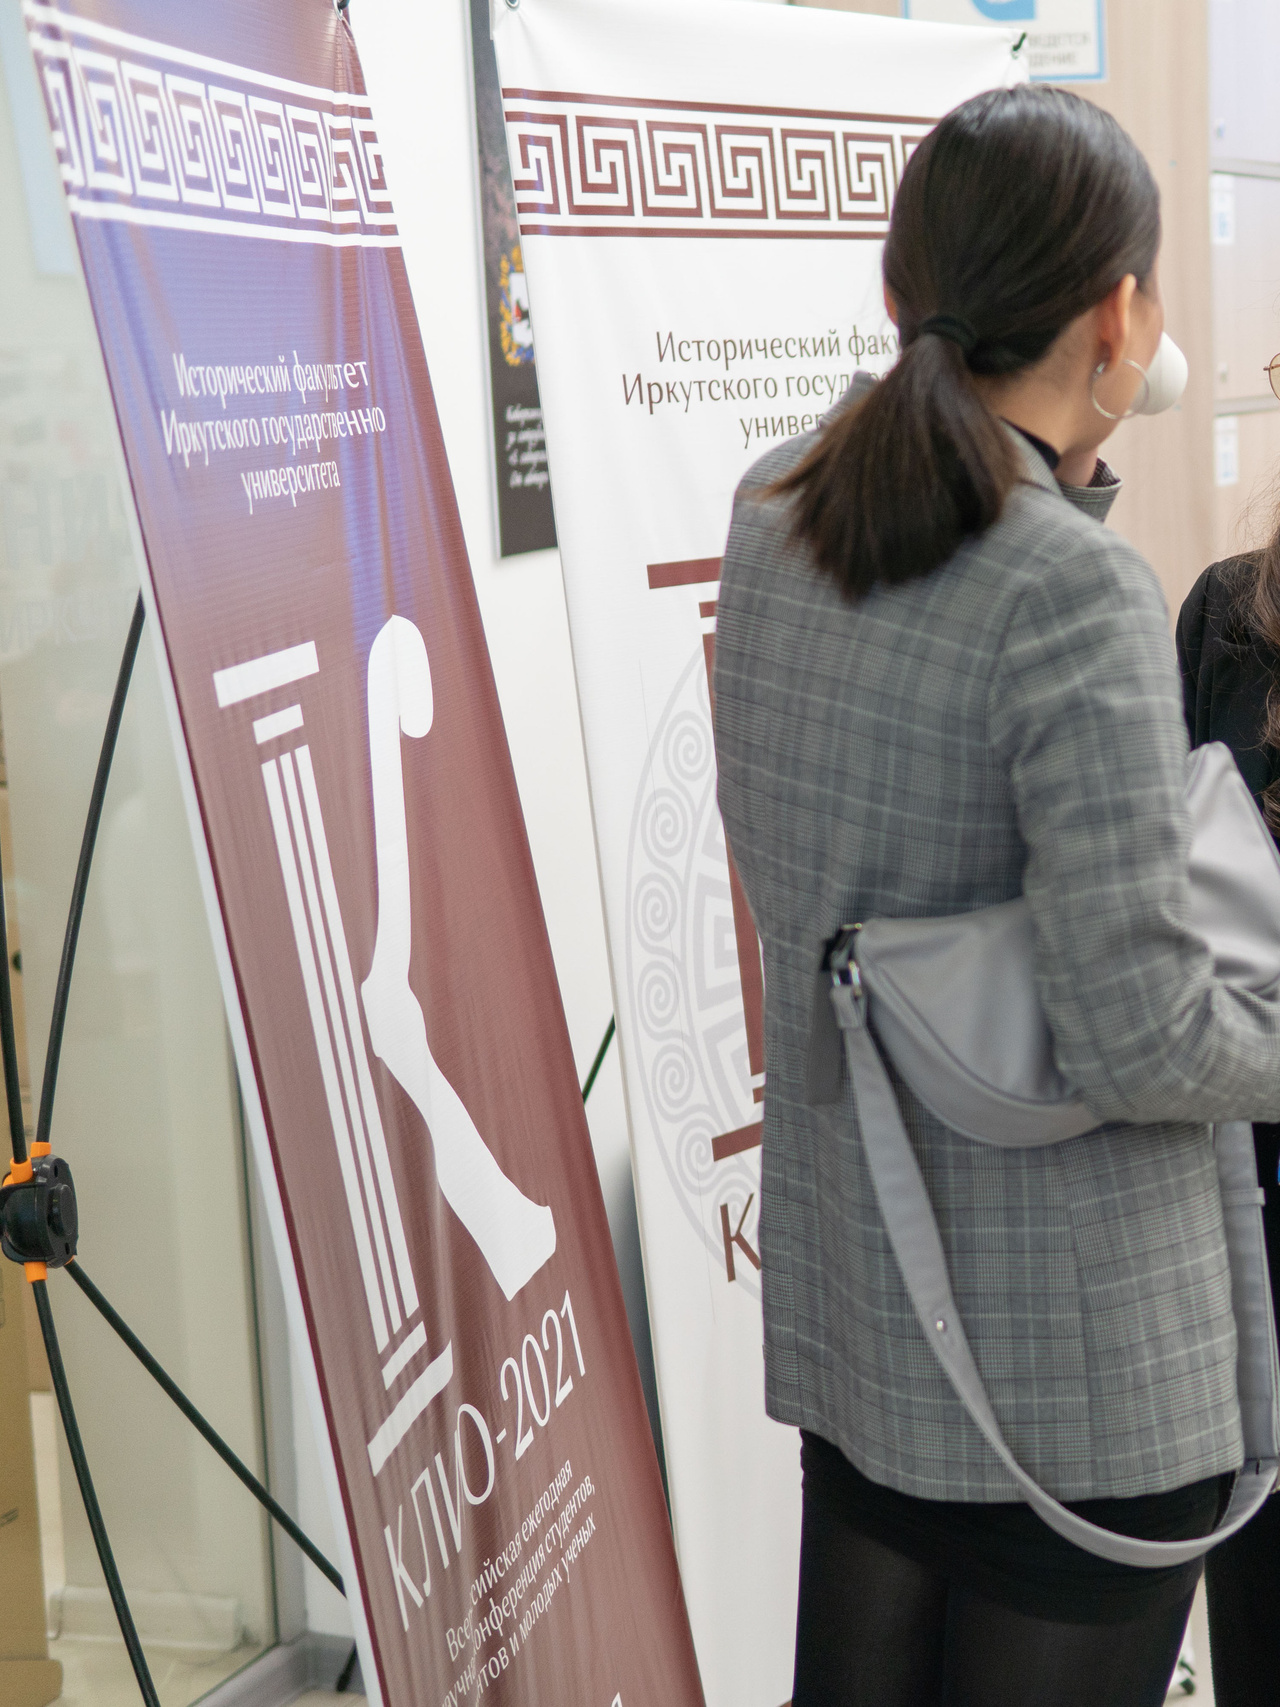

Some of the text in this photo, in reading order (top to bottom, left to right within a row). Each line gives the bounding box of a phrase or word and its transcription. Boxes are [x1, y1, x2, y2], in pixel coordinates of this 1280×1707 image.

[656, 329, 840, 370] Исторический
[173, 350, 368, 409] Исторический факультет
[622, 373, 777, 414] Иркутского
[161, 409, 260, 468] Иркутского
[241, 461, 340, 515] университета
[384, 1289, 586, 1632] КЛИО-2021
[522, 1459, 573, 1542] ежегодная
[473, 1543, 546, 1651] онференция
[545, 1475, 596, 1553] студентов,
[509, 1632, 520, 1657] и
[519, 1563, 563, 1644] молодых
[561, 1512, 597, 1584] ученых
